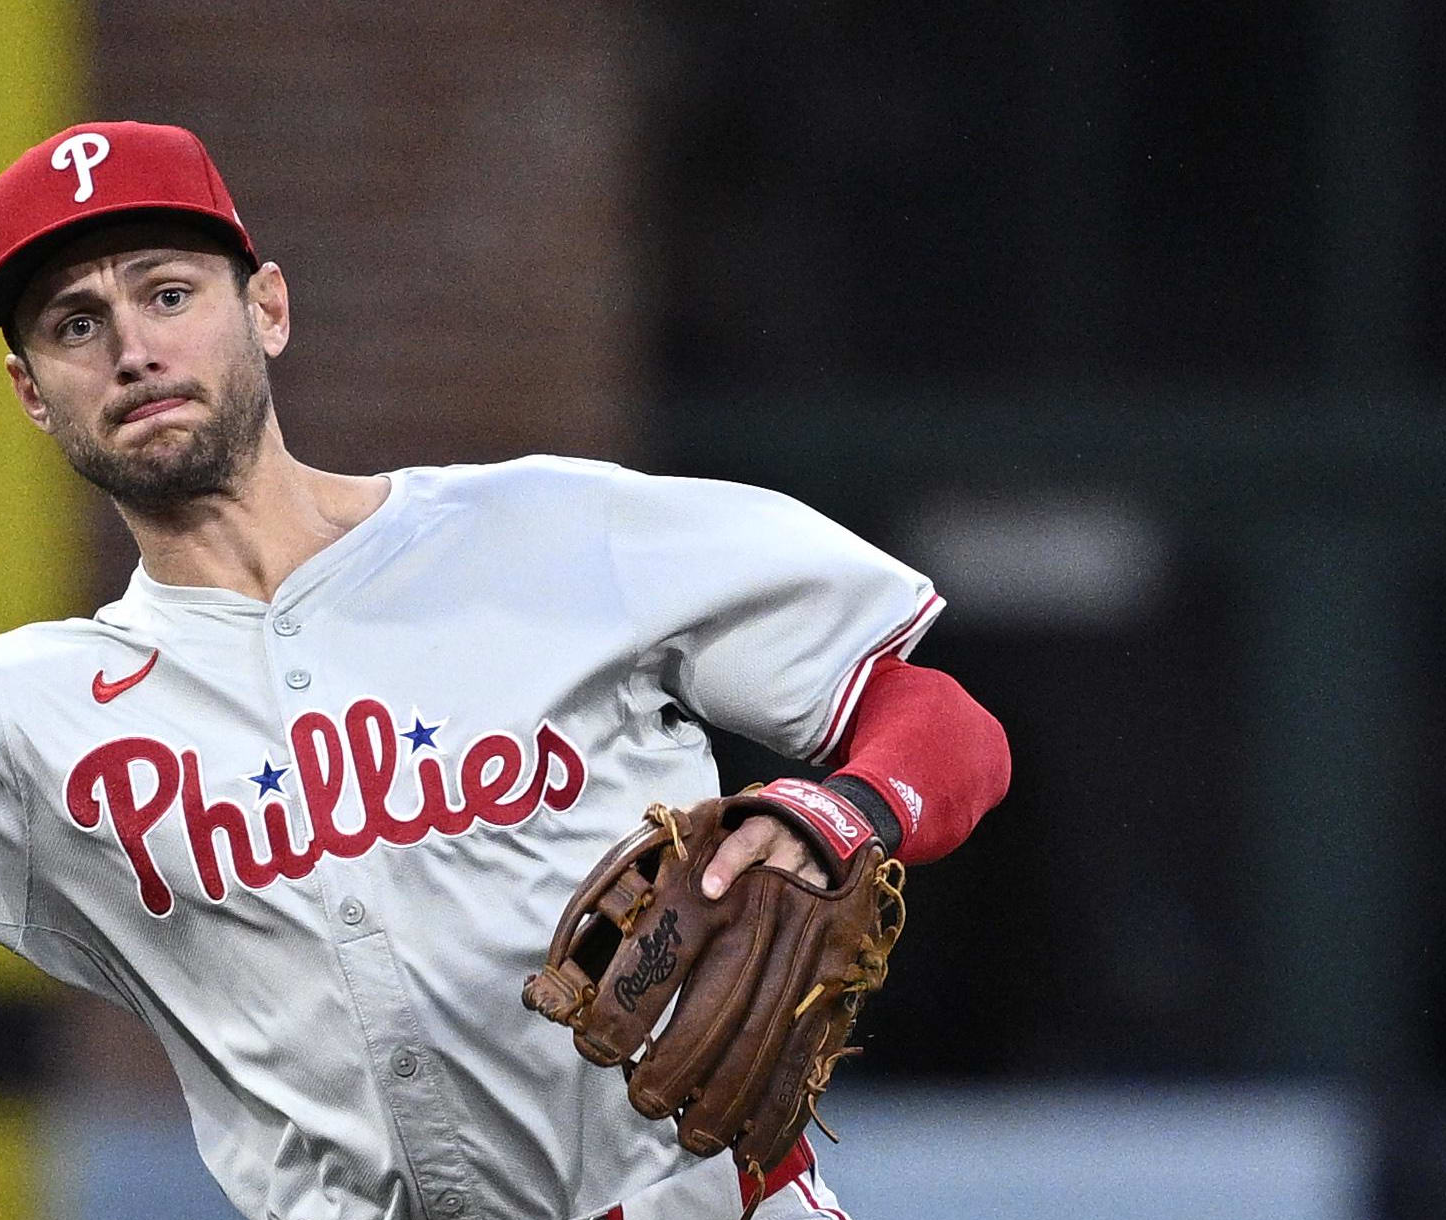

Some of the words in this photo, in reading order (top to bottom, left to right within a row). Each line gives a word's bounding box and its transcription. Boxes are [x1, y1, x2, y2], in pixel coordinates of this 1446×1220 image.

[51, 132, 110, 203] P
[62, 696, 589, 919] Phillies
[613, 907, 683, 1013] Rawlings
